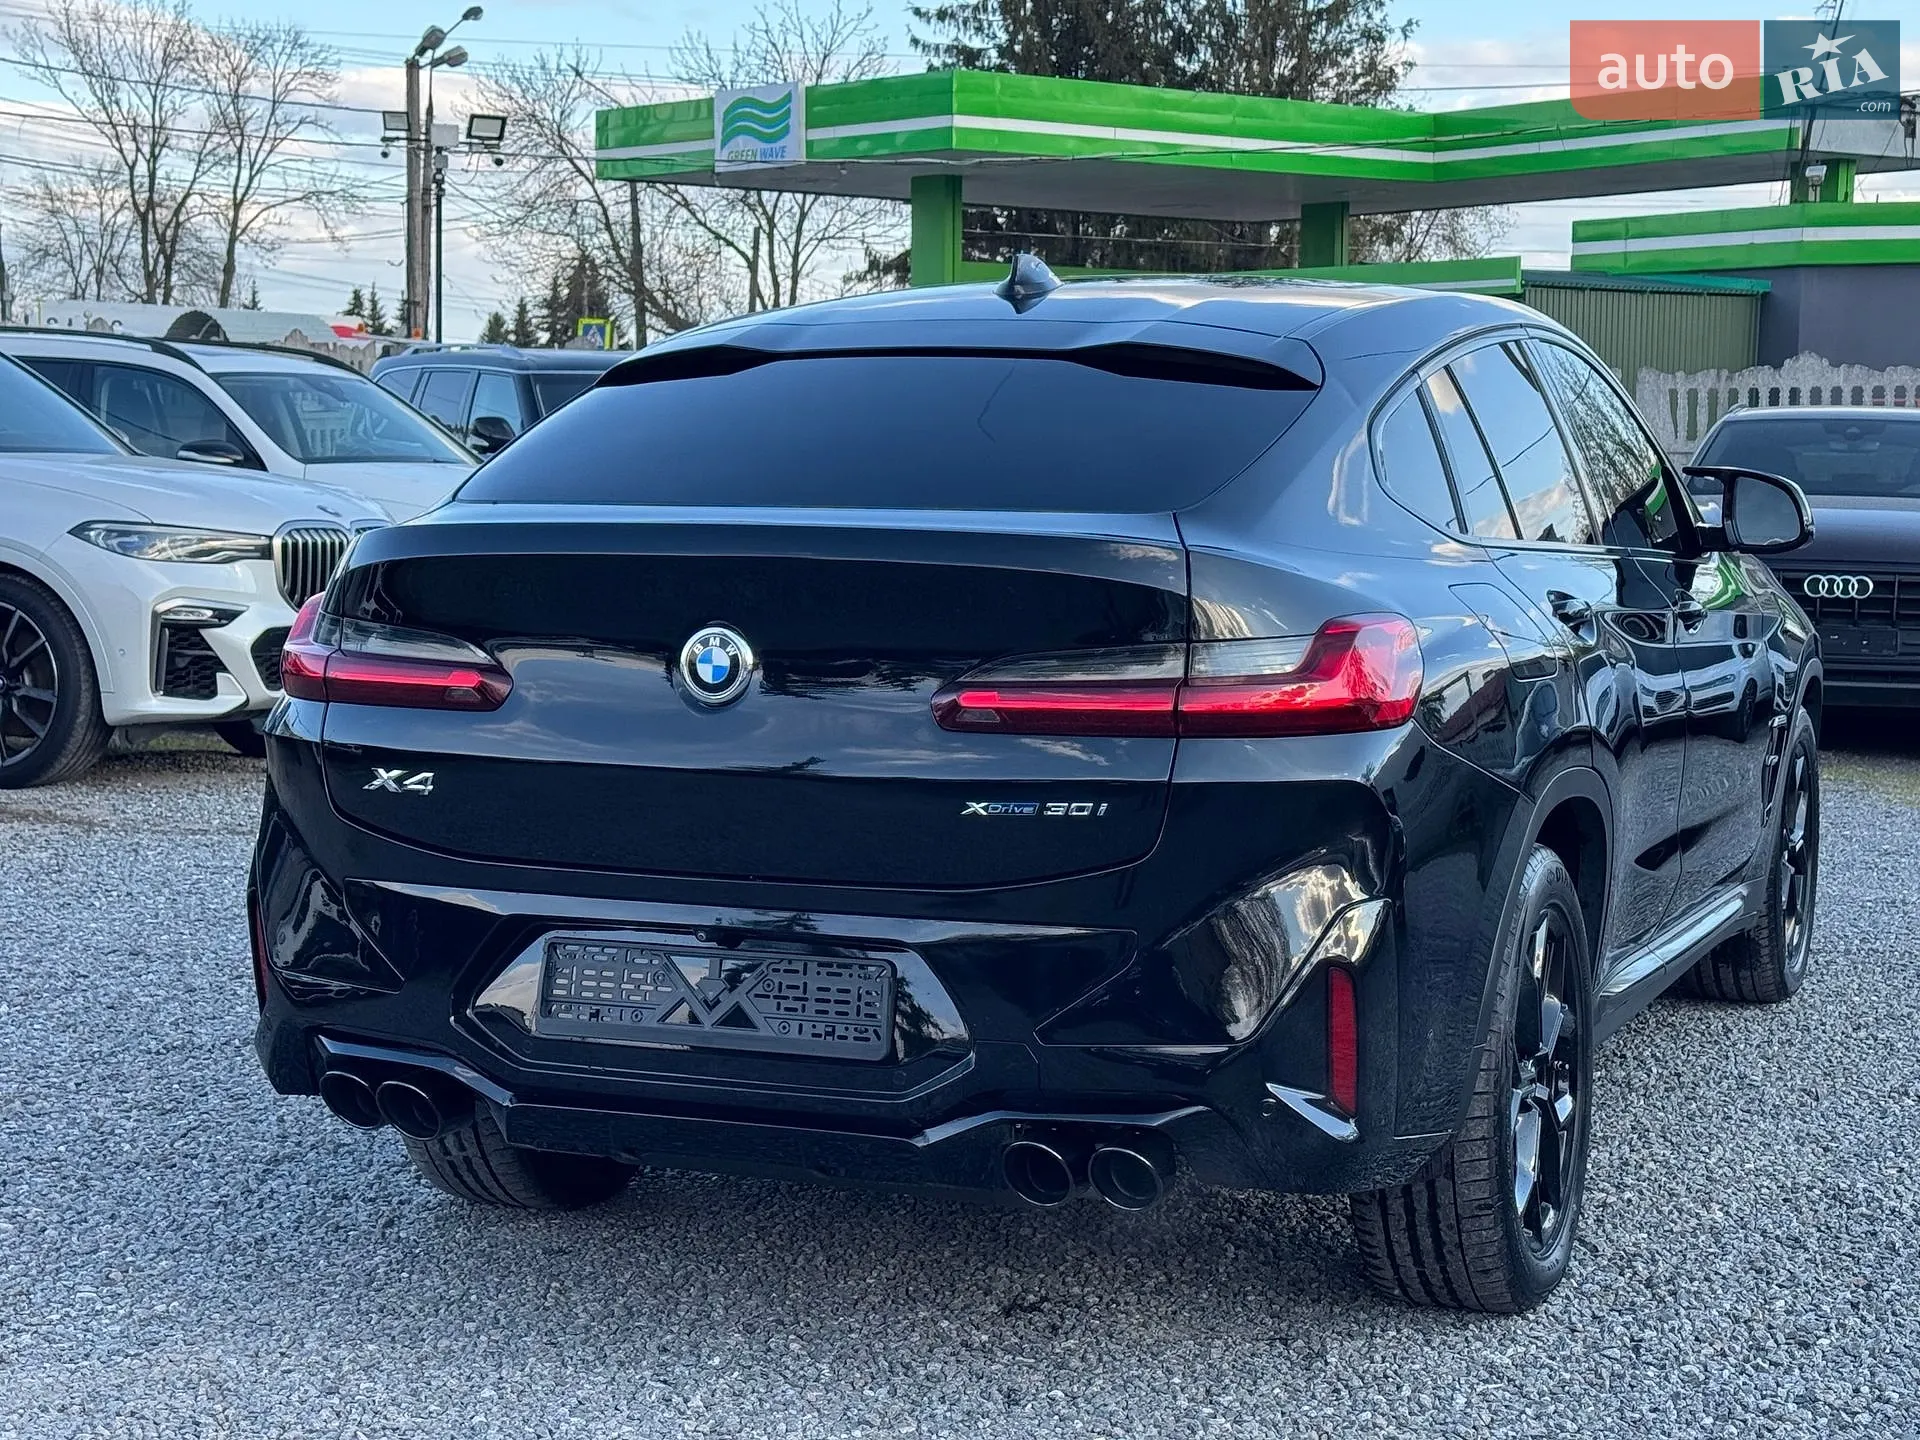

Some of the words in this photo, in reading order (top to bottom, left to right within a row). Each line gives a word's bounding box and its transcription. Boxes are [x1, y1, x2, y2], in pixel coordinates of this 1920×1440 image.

[727, 148, 758, 161] GREEN
[759, 145, 788, 160] WAVE
[692, 636, 738, 657] BMW
[361, 767, 435, 796] X4
